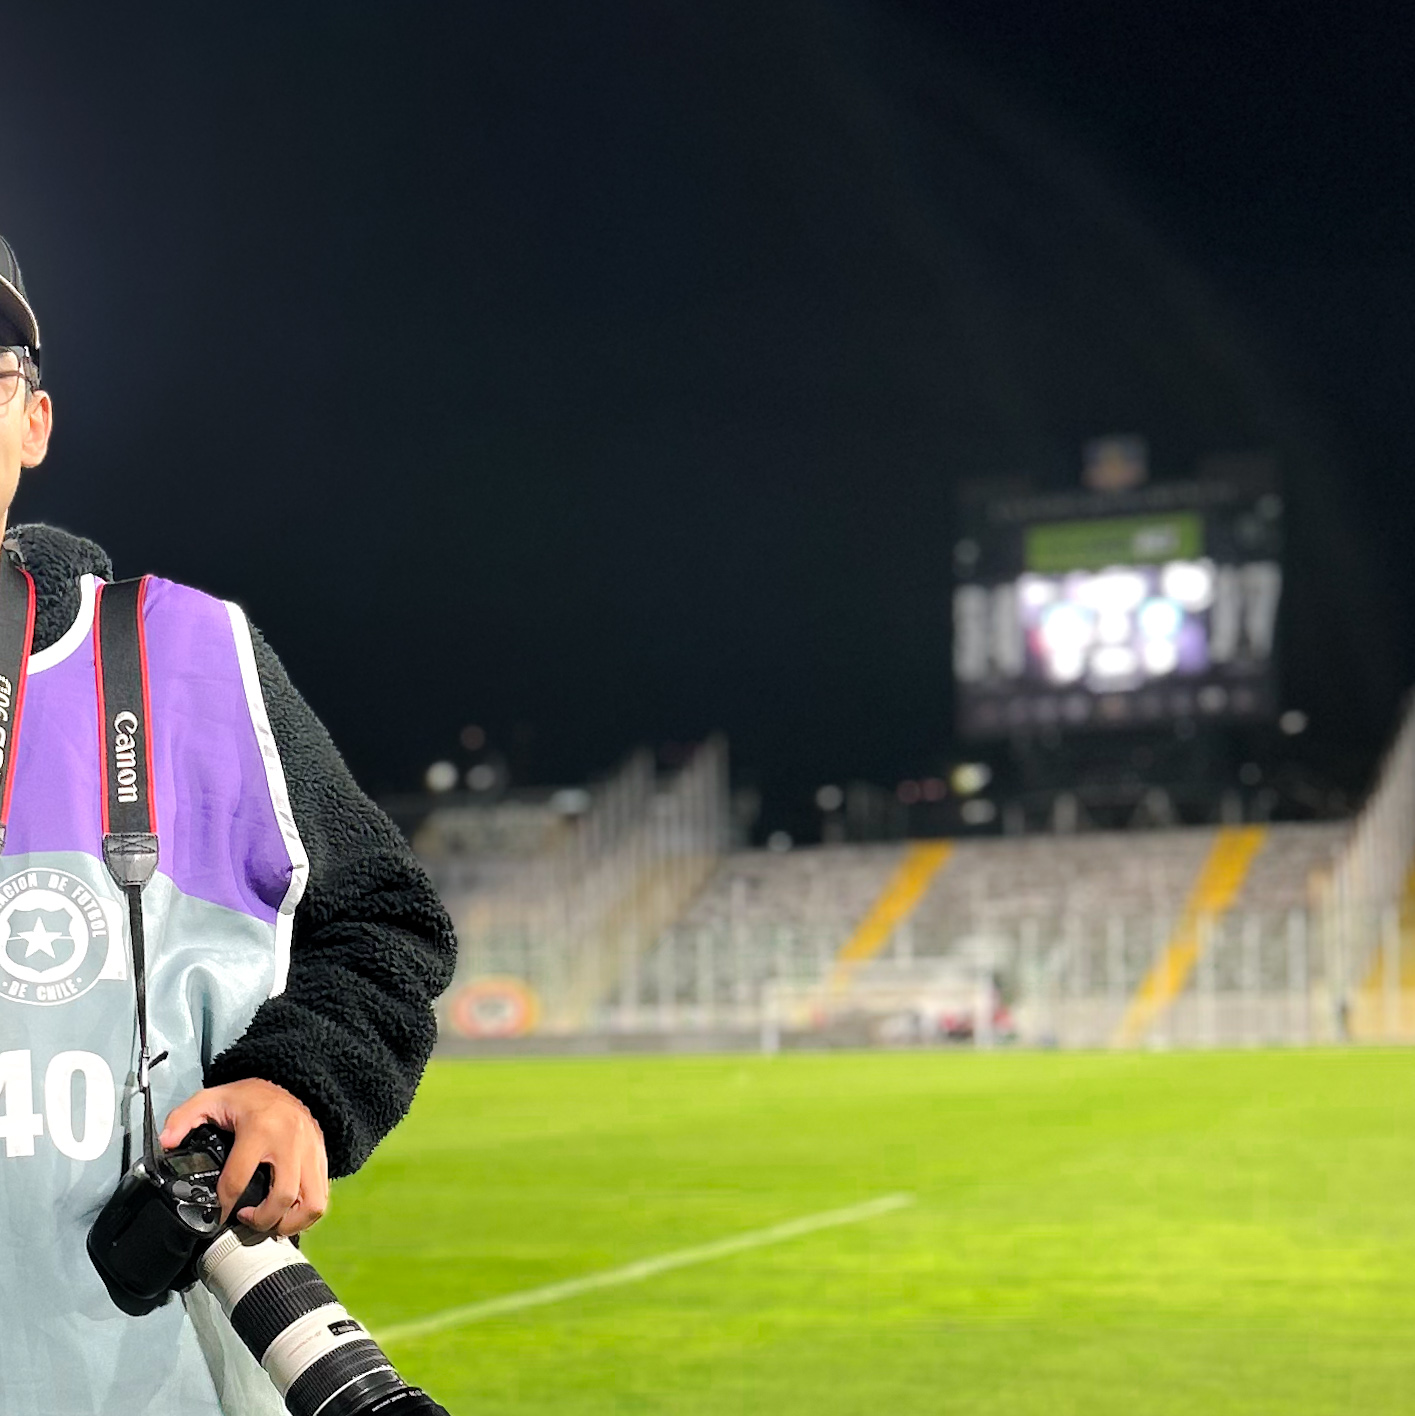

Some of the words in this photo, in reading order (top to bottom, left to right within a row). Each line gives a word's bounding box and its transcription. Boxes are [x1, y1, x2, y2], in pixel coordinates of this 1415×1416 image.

[114, 710, 138, 803] Canon
[47, 873, 69, 892] DE
[70, 884, 108, 939] FUTBOL
[7, 980, 29, 999] DE
[35, 977, 79, 1001] CHILE
